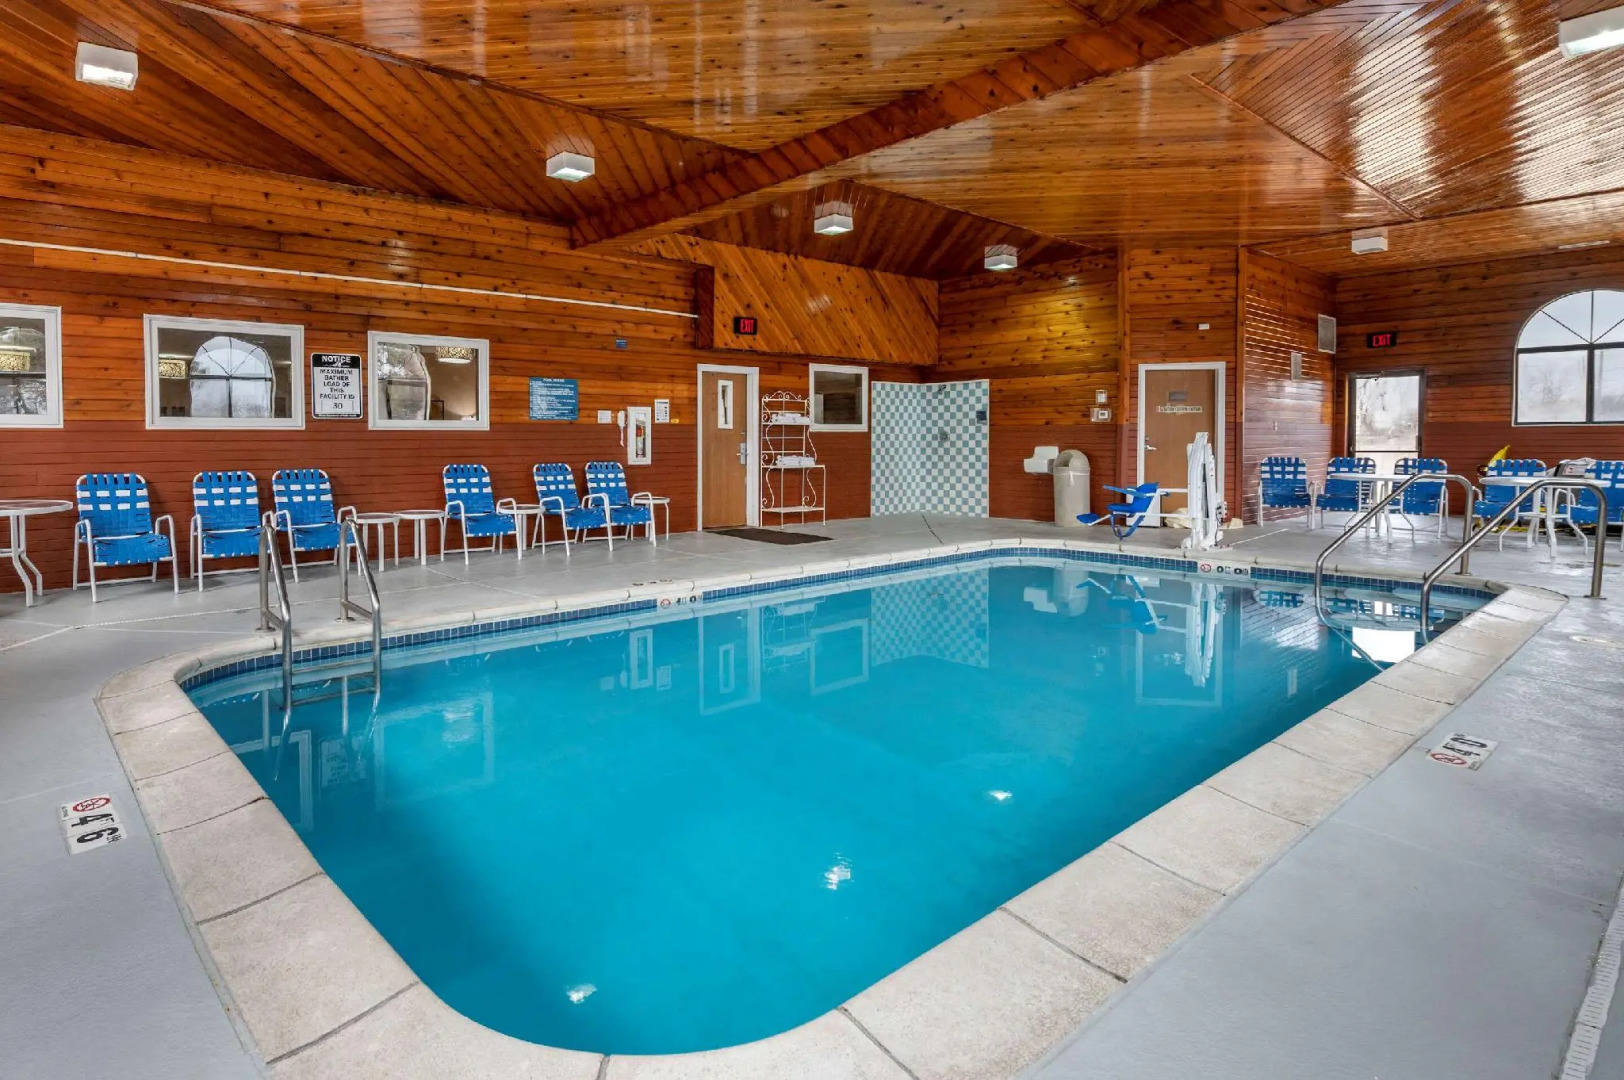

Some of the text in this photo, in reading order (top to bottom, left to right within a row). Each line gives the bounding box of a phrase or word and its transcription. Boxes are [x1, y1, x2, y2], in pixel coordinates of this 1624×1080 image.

[740, 318, 755, 332] EXIT
[1372, 334, 1391, 347] EXIT
[321, 355, 352, 363] NOTICE
[77, 827, 119, 844] 6
